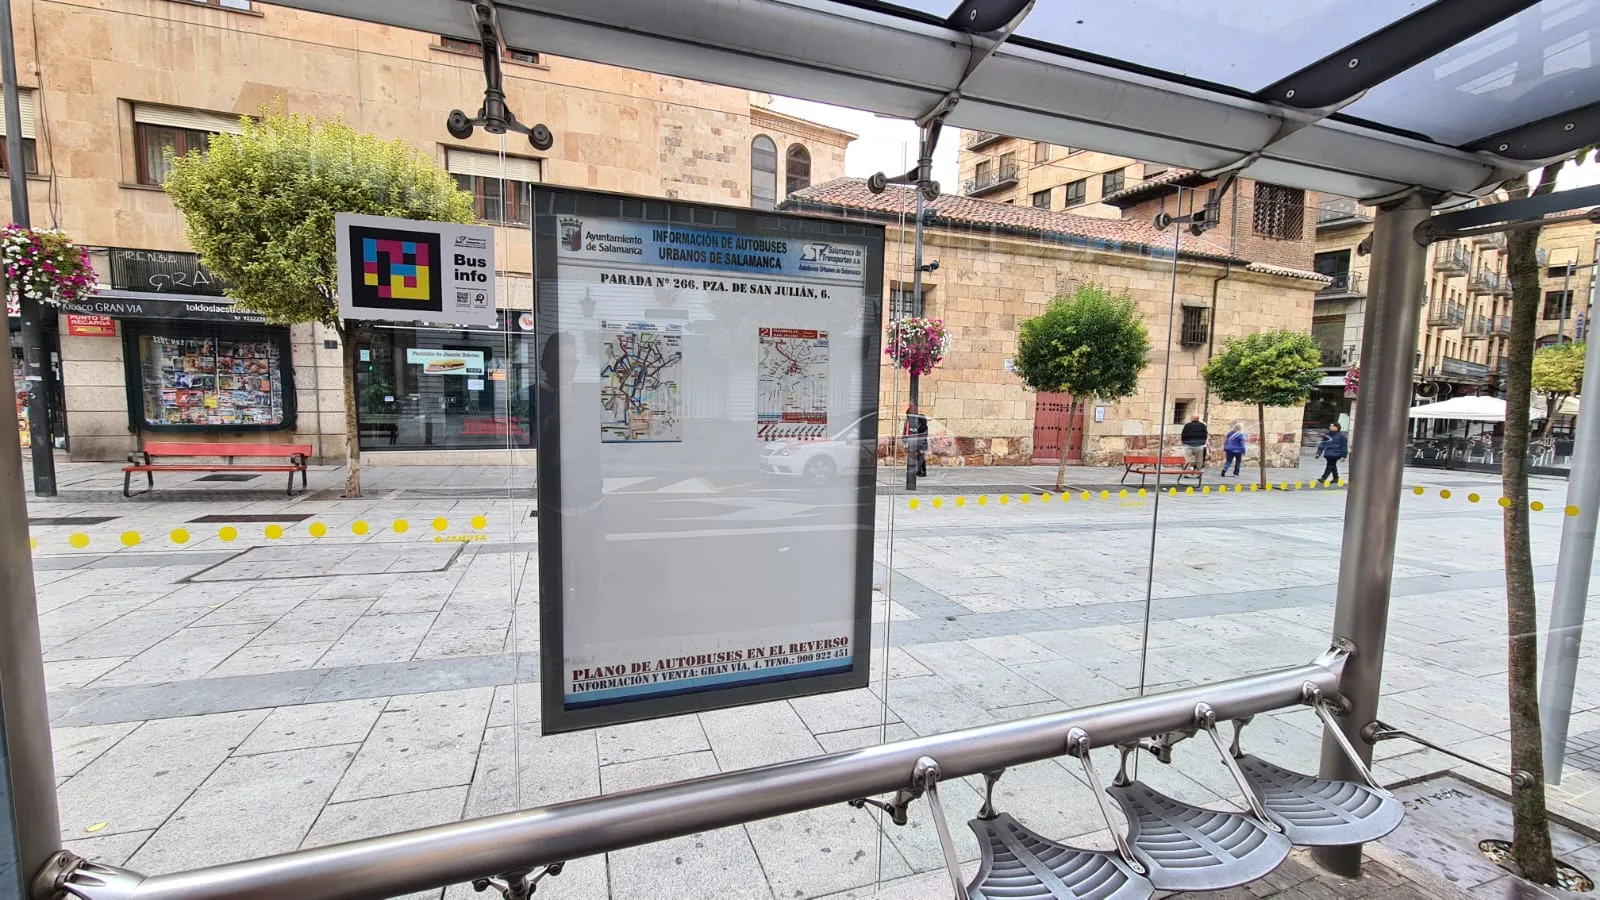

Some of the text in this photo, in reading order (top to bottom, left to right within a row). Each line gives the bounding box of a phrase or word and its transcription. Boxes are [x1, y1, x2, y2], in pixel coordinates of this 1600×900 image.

[585, 231, 643, 244] Ayuntamiento
[652, 229, 787, 254] INFORMACIÓN DE AUTOBUSES
[585, 242, 642, 255] de Salamanca
[118, 250, 177, 263] PRENSA
[454, 253, 487, 268] Bus
[658, 247, 782, 269] URBANOS DE SALAMANCA
[454, 268, 487, 283] info
[600, 273, 830, 299] PARADA Nº 266. PZA. DE SAN JULIÁN, 6.
[95, 302, 124, 313] GRAN
[126, 304, 143, 313] VIA
[760, 328, 768, 337] 2
[572, 636, 849, 681] PLANO DE AUTOBUSES EN EL REVERSO
[572, 673, 649, 693] INFORMACIÓN
[652, 673, 659, 682] Y
[661, 669, 698, 681] VENTA:
[701, 664, 728, 676] GRAN
[731, 661, 750, 672] VÍA,
[797, 653, 813, 662] 900
[815, 651, 832, 661] 922
[833, 648, 848, 658] 451
